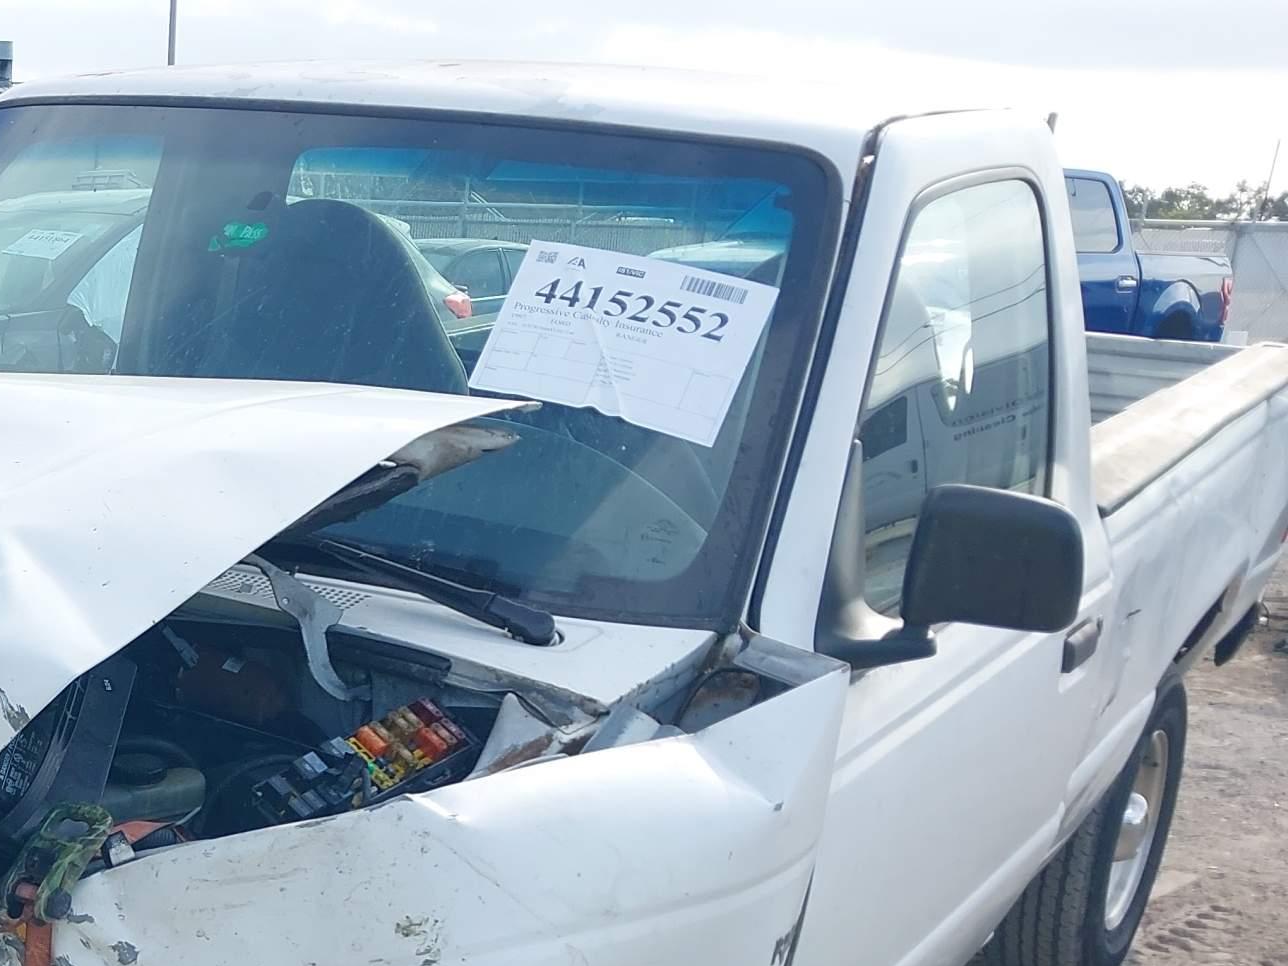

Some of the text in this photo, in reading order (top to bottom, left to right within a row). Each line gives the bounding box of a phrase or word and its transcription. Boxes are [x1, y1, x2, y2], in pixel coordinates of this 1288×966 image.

[514, 301, 570, 317] Progressive
[614, 320, 664, 338] Insurance
[535, 278, 730, 342] 44152552
